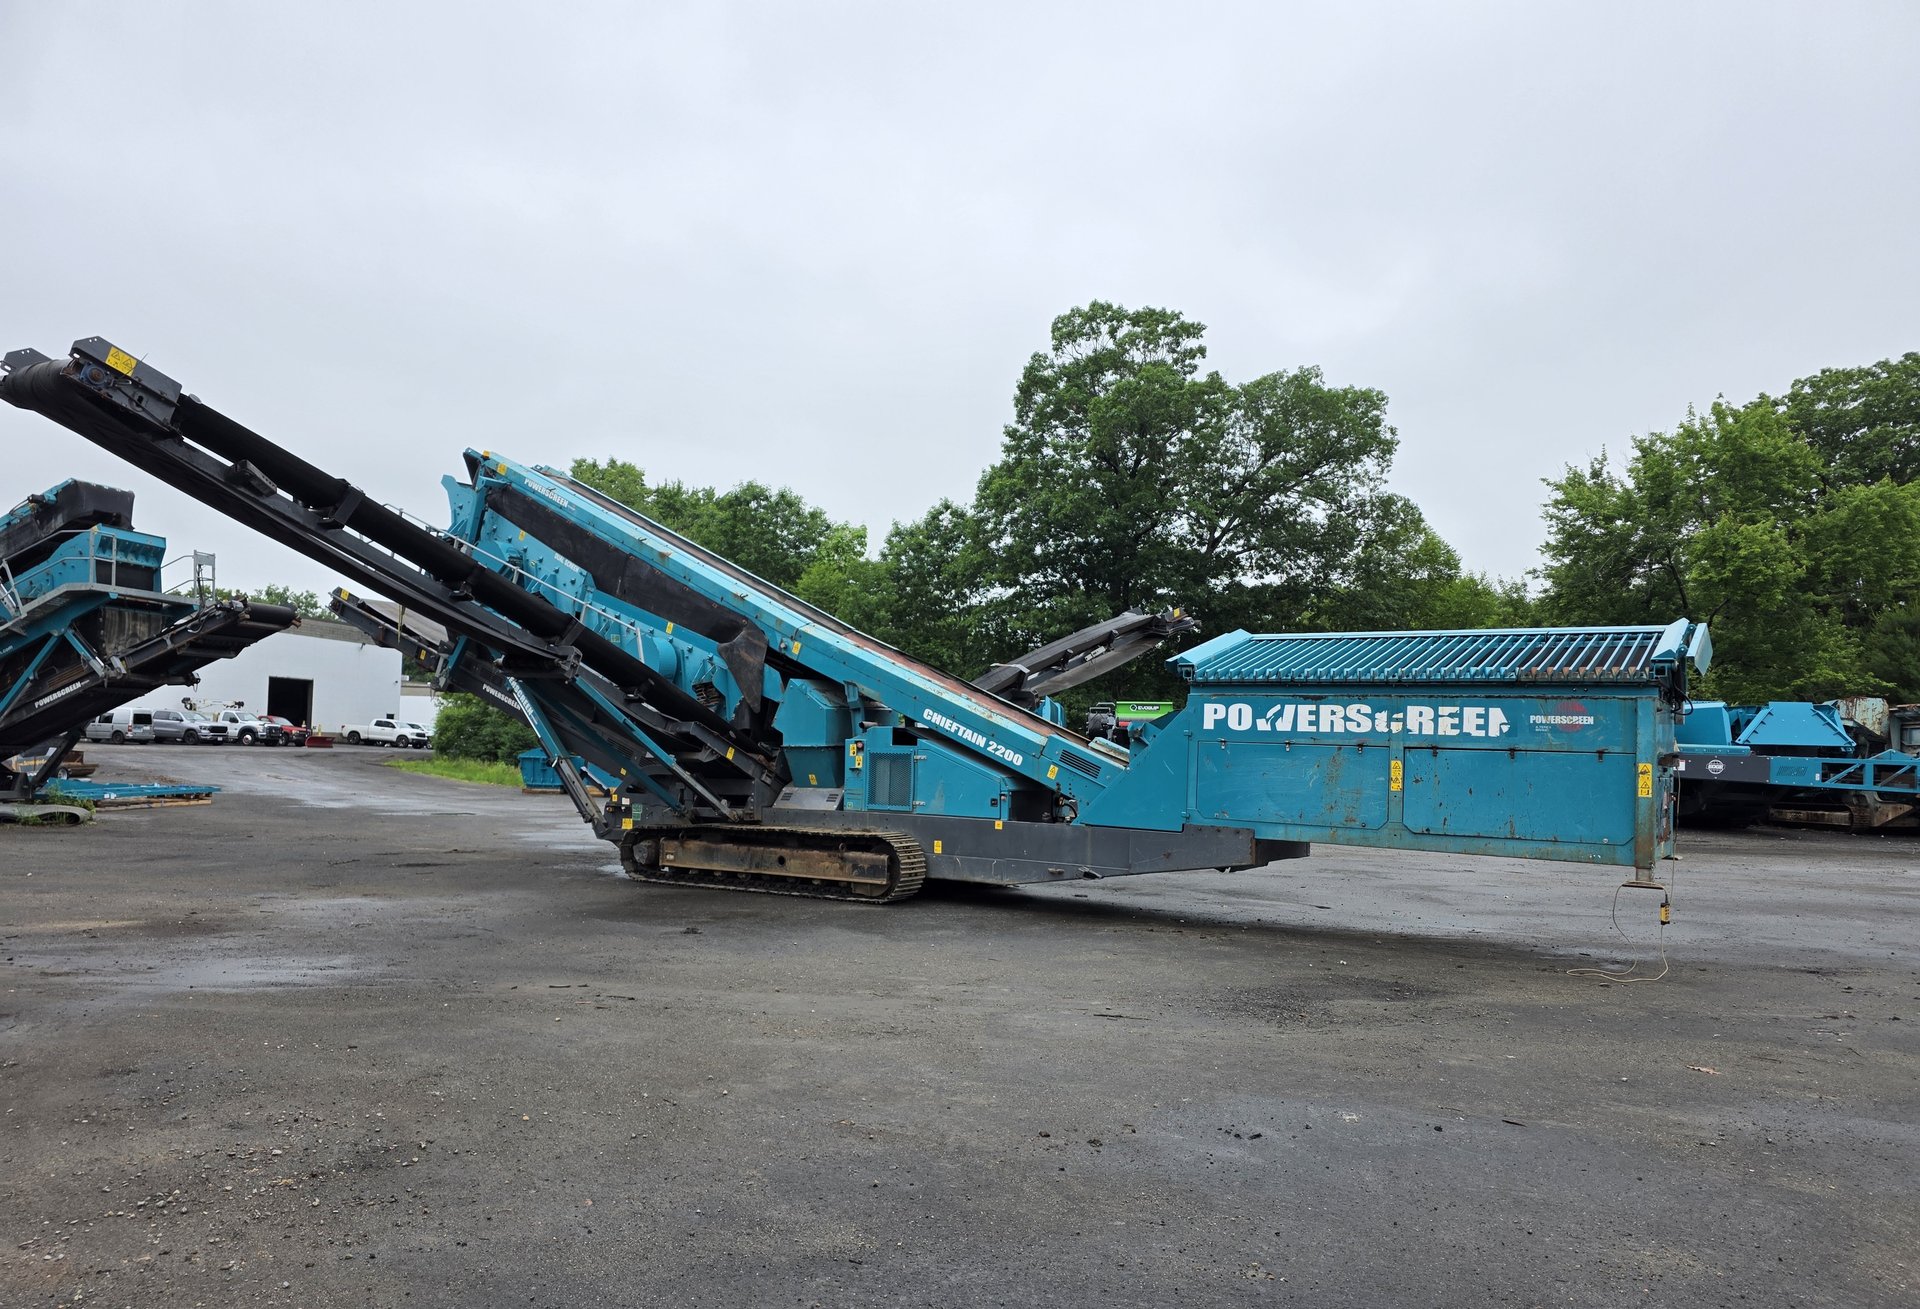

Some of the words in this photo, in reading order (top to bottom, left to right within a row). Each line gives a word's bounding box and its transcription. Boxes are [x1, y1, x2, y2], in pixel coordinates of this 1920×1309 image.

[524, 478, 569, 508] POWERSCREEN
[34, 681, 82, 709] POWERSCREEN
[1529, 714, 1595, 725] POWERSCREEN
[923, 708, 987, 748] CHIEFTAIN
[986, 740, 1024, 766] 2200
